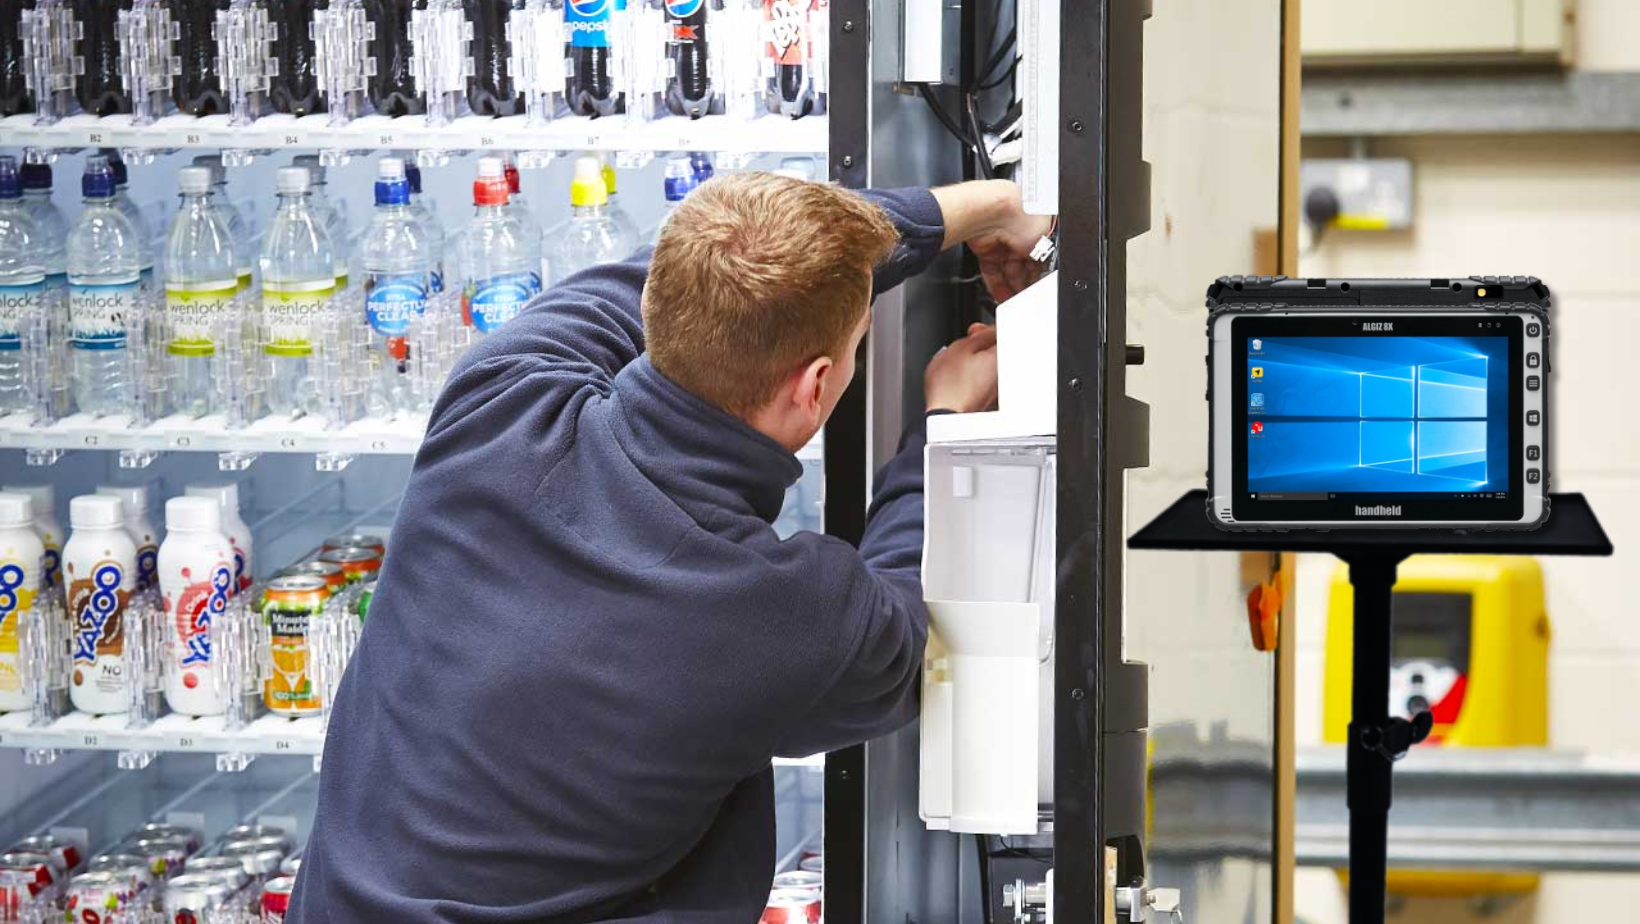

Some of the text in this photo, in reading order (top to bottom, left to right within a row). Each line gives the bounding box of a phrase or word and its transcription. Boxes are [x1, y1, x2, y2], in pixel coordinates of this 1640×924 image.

[89, 134, 102, 143] B2
[187, 135, 200, 144] B3
[285, 136, 298, 145] B4
[170, 299, 225, 315] wenlock
[269, 299, 324, 315] wenlock
[472, 302, 524, 313] PERFECT
[1362, 322, 1394, 332] ALGIZ 8X
[85, 435, 98, 445] C2
[281, 437, 295, 447] C4
[371, 440, 385, 451] C5
[1528, 449, 1538, 458] F1
[1528, 472, 1538, 481] F2
[1354, 505, 1402, 517] handheld
[272, 613, 309, 624] Minute
[276, 623, 305, 634] Maid
[102, 665, 122, 676] NO
[85, 736, 98, 746] D2
[276, 741, 290, 750] D4
